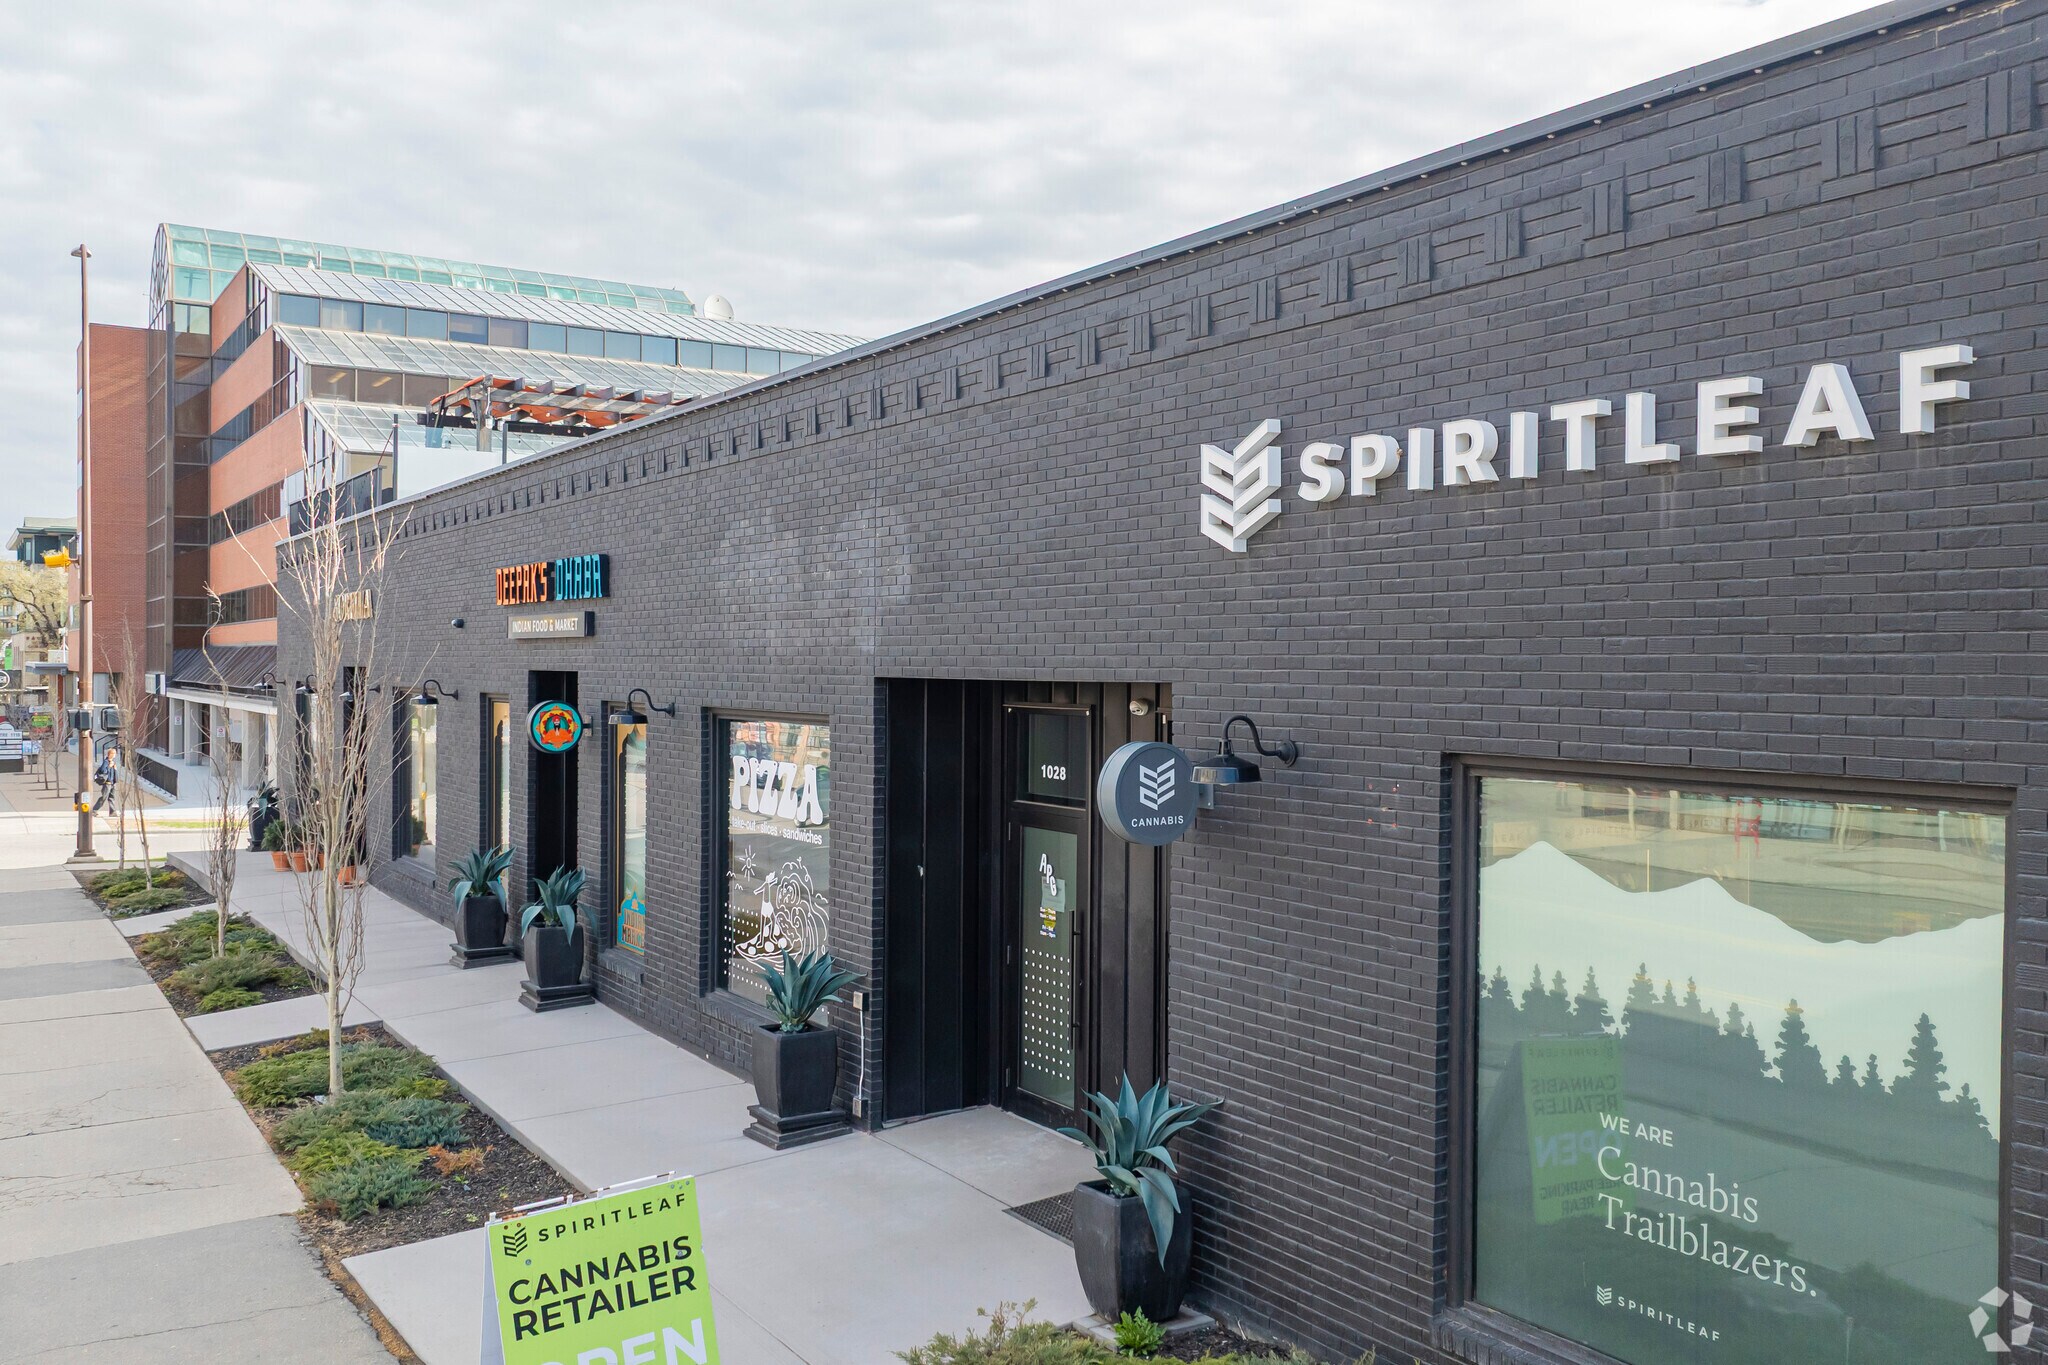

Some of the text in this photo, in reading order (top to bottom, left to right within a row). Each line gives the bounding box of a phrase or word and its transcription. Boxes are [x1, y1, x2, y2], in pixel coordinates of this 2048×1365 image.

[1298, 344, 1974, 502] SPIRITLEAF
[496, 554, 603, 606] DEEPAK'S DHABA
[512, 620, 531, 633] INDIAN
[532, 619, 548, 633] FOOD
[555, 617, 578, 631] MARKET
[731, 755, 823, 825] PIZZA
[1041, 764, 1067, 781] 1028
[731, 816, 823, 845] take-out slices sandwiches
[1131, 815, 1184, 828] CANNABIS
[1599, 1112, 1674, 1147] WE ARE
[1597, 1146, 1759, 1223] Cannabis
[538, 1193, 686, 1242] SPIRITLEAF
[508, 1235, 693, 1305] CANNABIS
[1597, 1193, 1817, 1298] Trailblazers.
[512, 1265, 697, 1342] RETAILER
[1618, 1296, 1720, 1341] SPIRITLEAF
